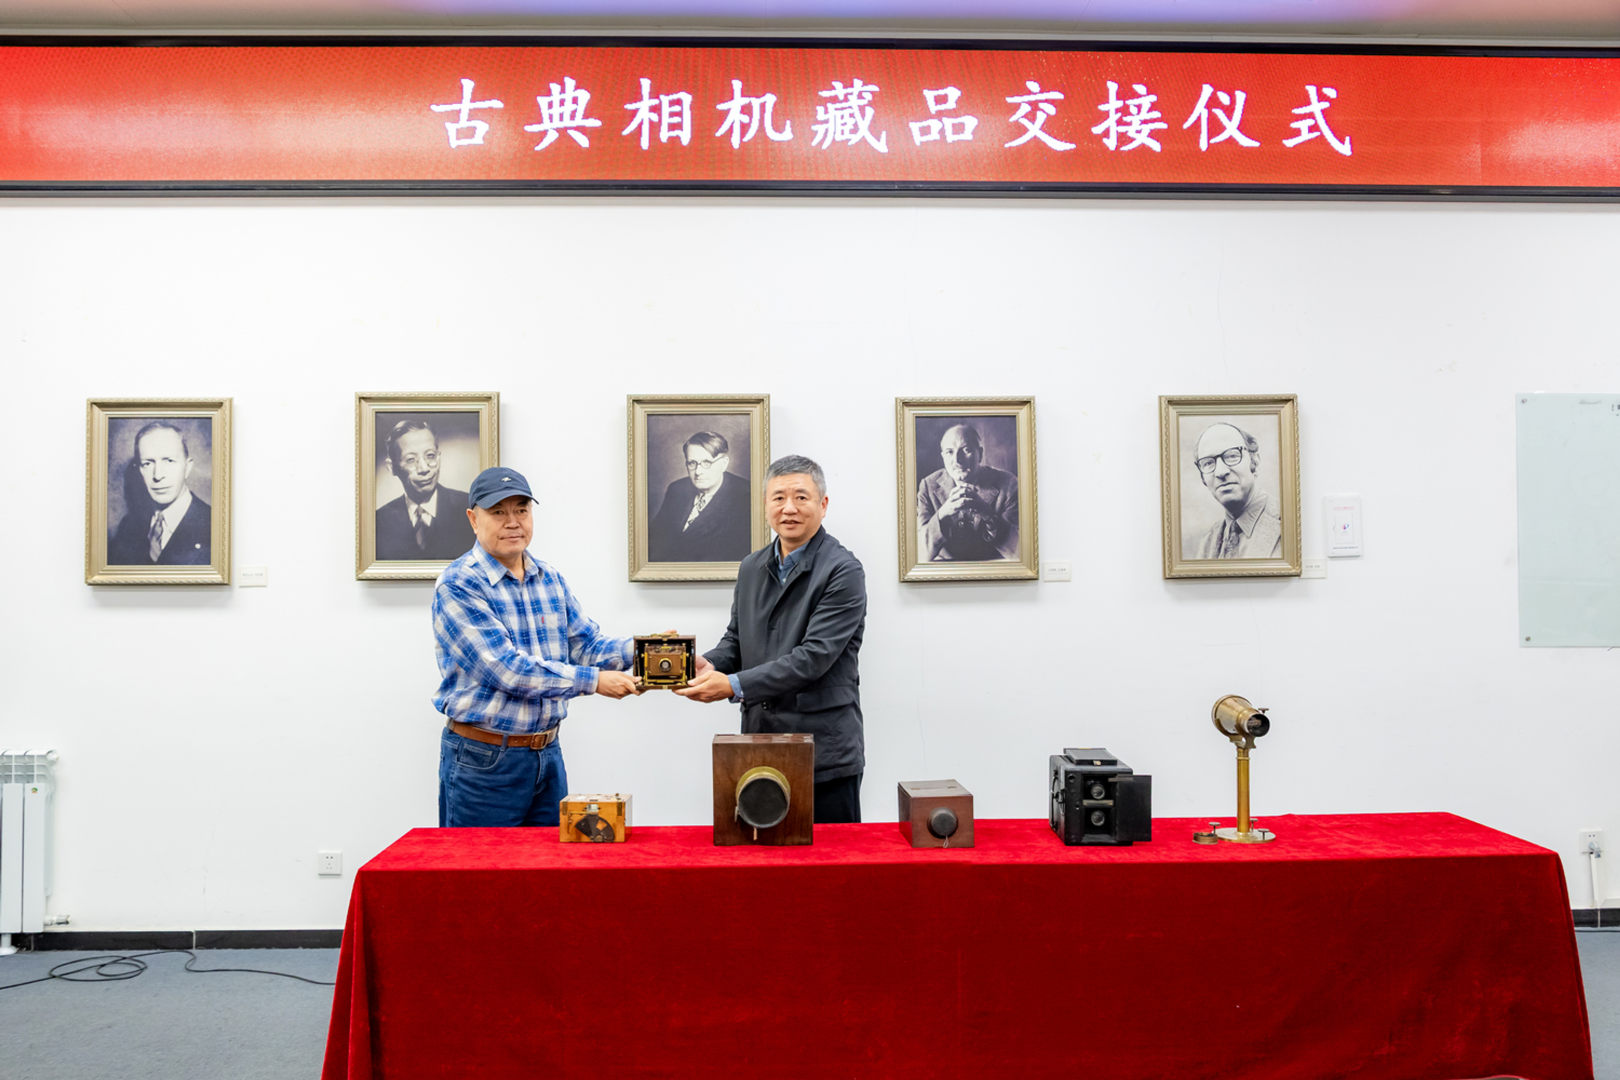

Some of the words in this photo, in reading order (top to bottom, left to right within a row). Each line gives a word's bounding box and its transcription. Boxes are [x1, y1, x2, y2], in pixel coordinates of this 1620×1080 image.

[429, 76, 1353, 157] 古典相机藏品交接仪式
